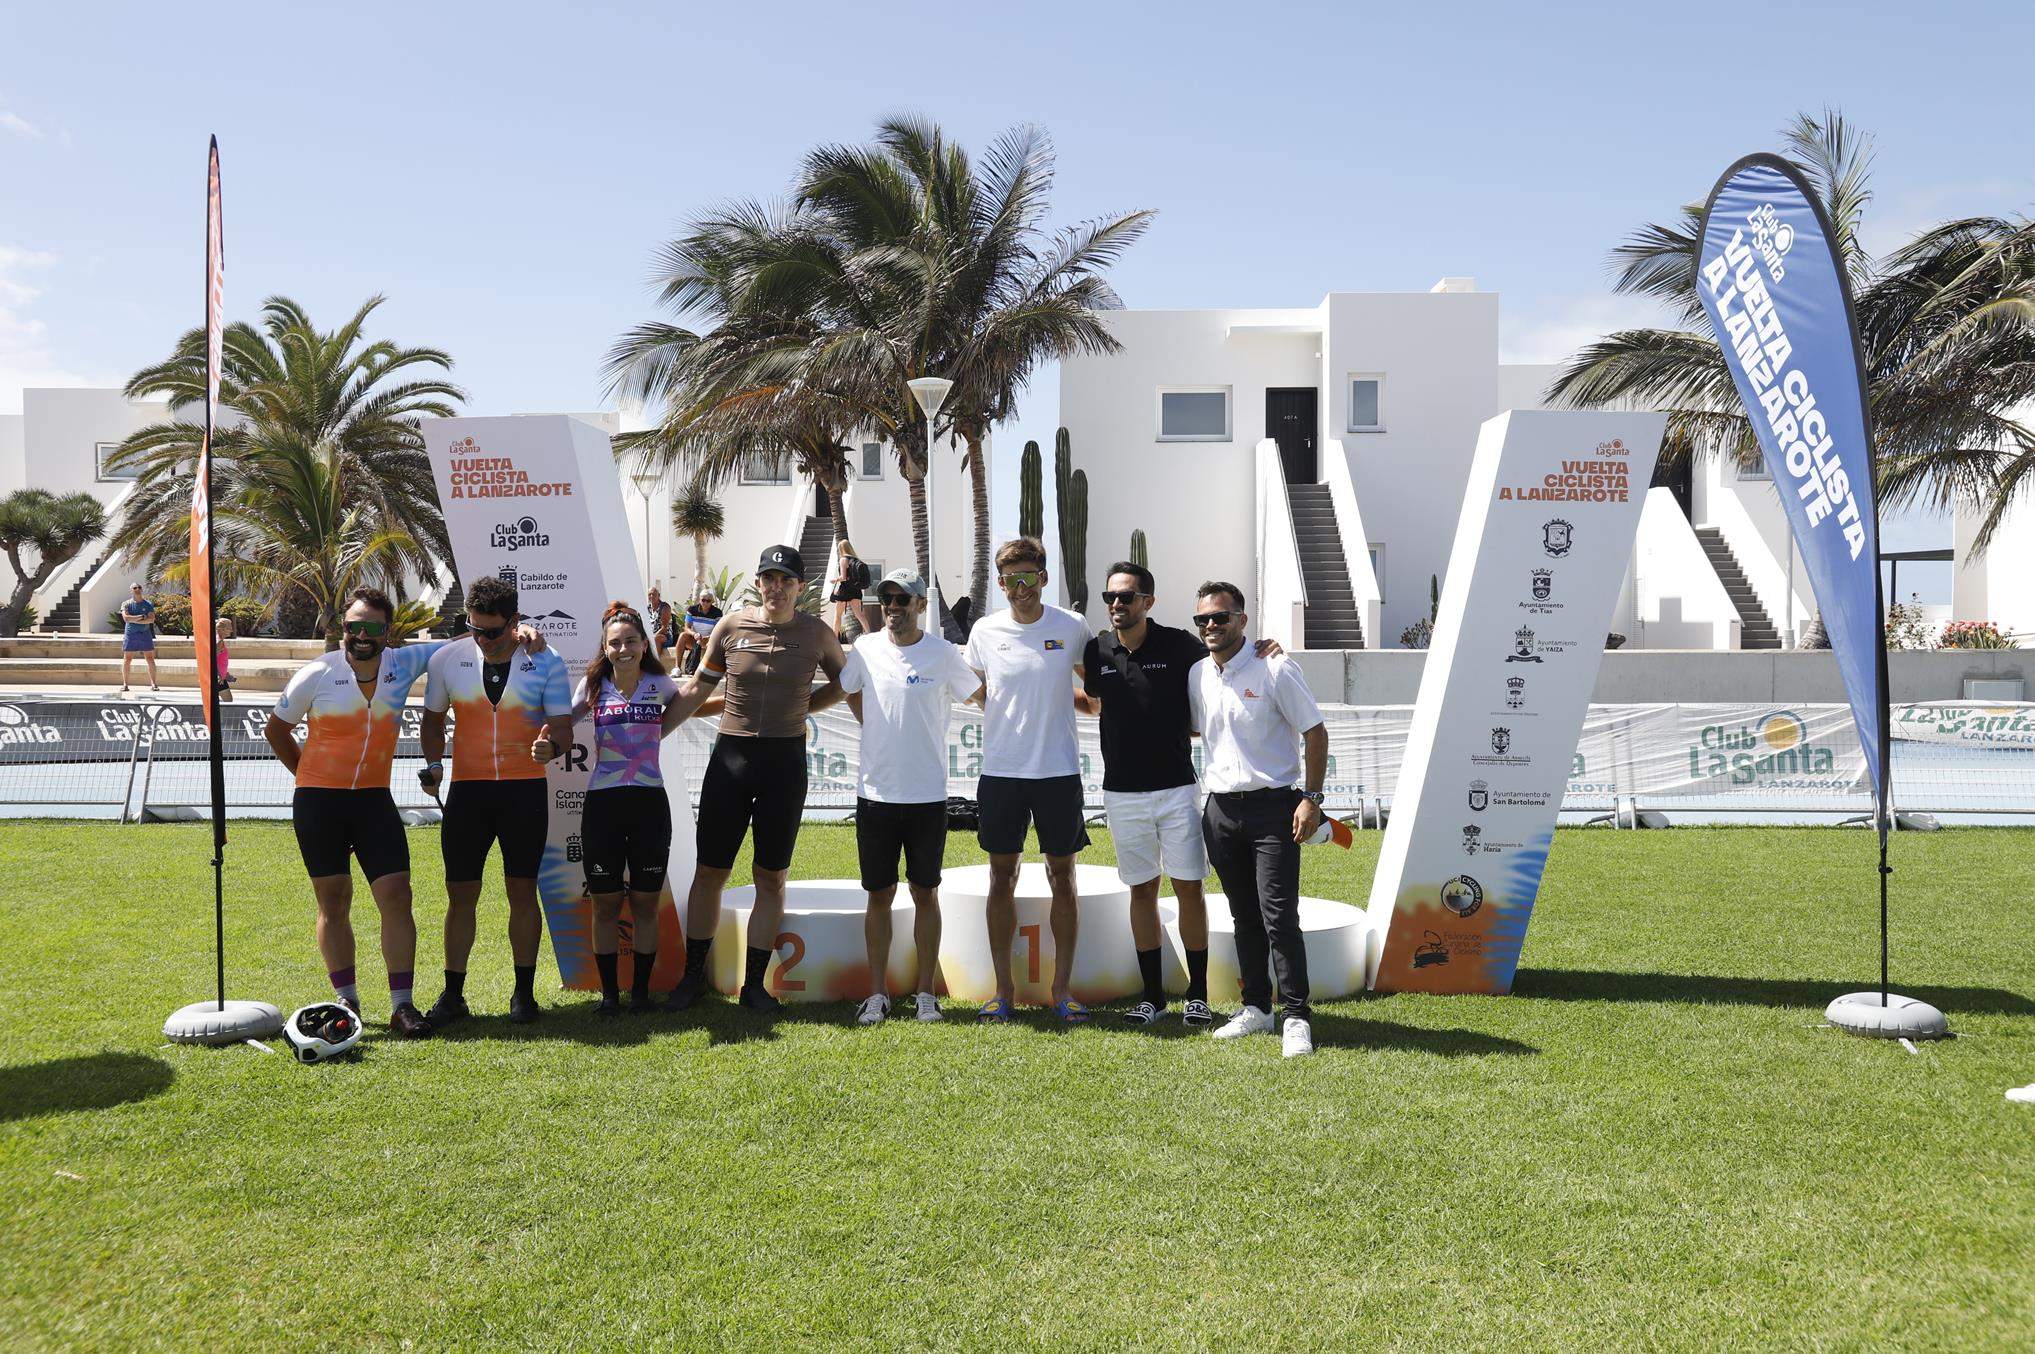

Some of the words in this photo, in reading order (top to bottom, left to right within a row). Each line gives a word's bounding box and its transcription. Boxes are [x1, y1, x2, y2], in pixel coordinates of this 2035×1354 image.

[1760, 202, 1779, 233] Club
[1703, 254, 1729, 293] A
[1724, 228, 1793, 376] VUELTA
[1783, 369, 1865, 562] CICLISTA
[1713, 285, 1832, 529] LANZAROTE
[451, 458, 513, 472] VUELTA
[1562, 461, 1629, 475] VUELTA
[451, 471, 528, 485] CICLISTA
[1544, 474, 1628, 488] CICLISTA
[451, 486, 464, 498] A
[468, 483, 572, 498] LANZAROTE
[1499, 488, 1513, 500] A
[1517, 488, 1629, 502] LANZAROTE
[495, 523, 518, 535] Club
[556, 573, 568, 581] de
[521, 582, 565, 590] Lanzarote
[598, 704, 660, 717] LABORAL
[1701, 726, 1756, 750] Club
[1018, 924, 1040, 984] 1
[772, 933, 806, 991] 2
